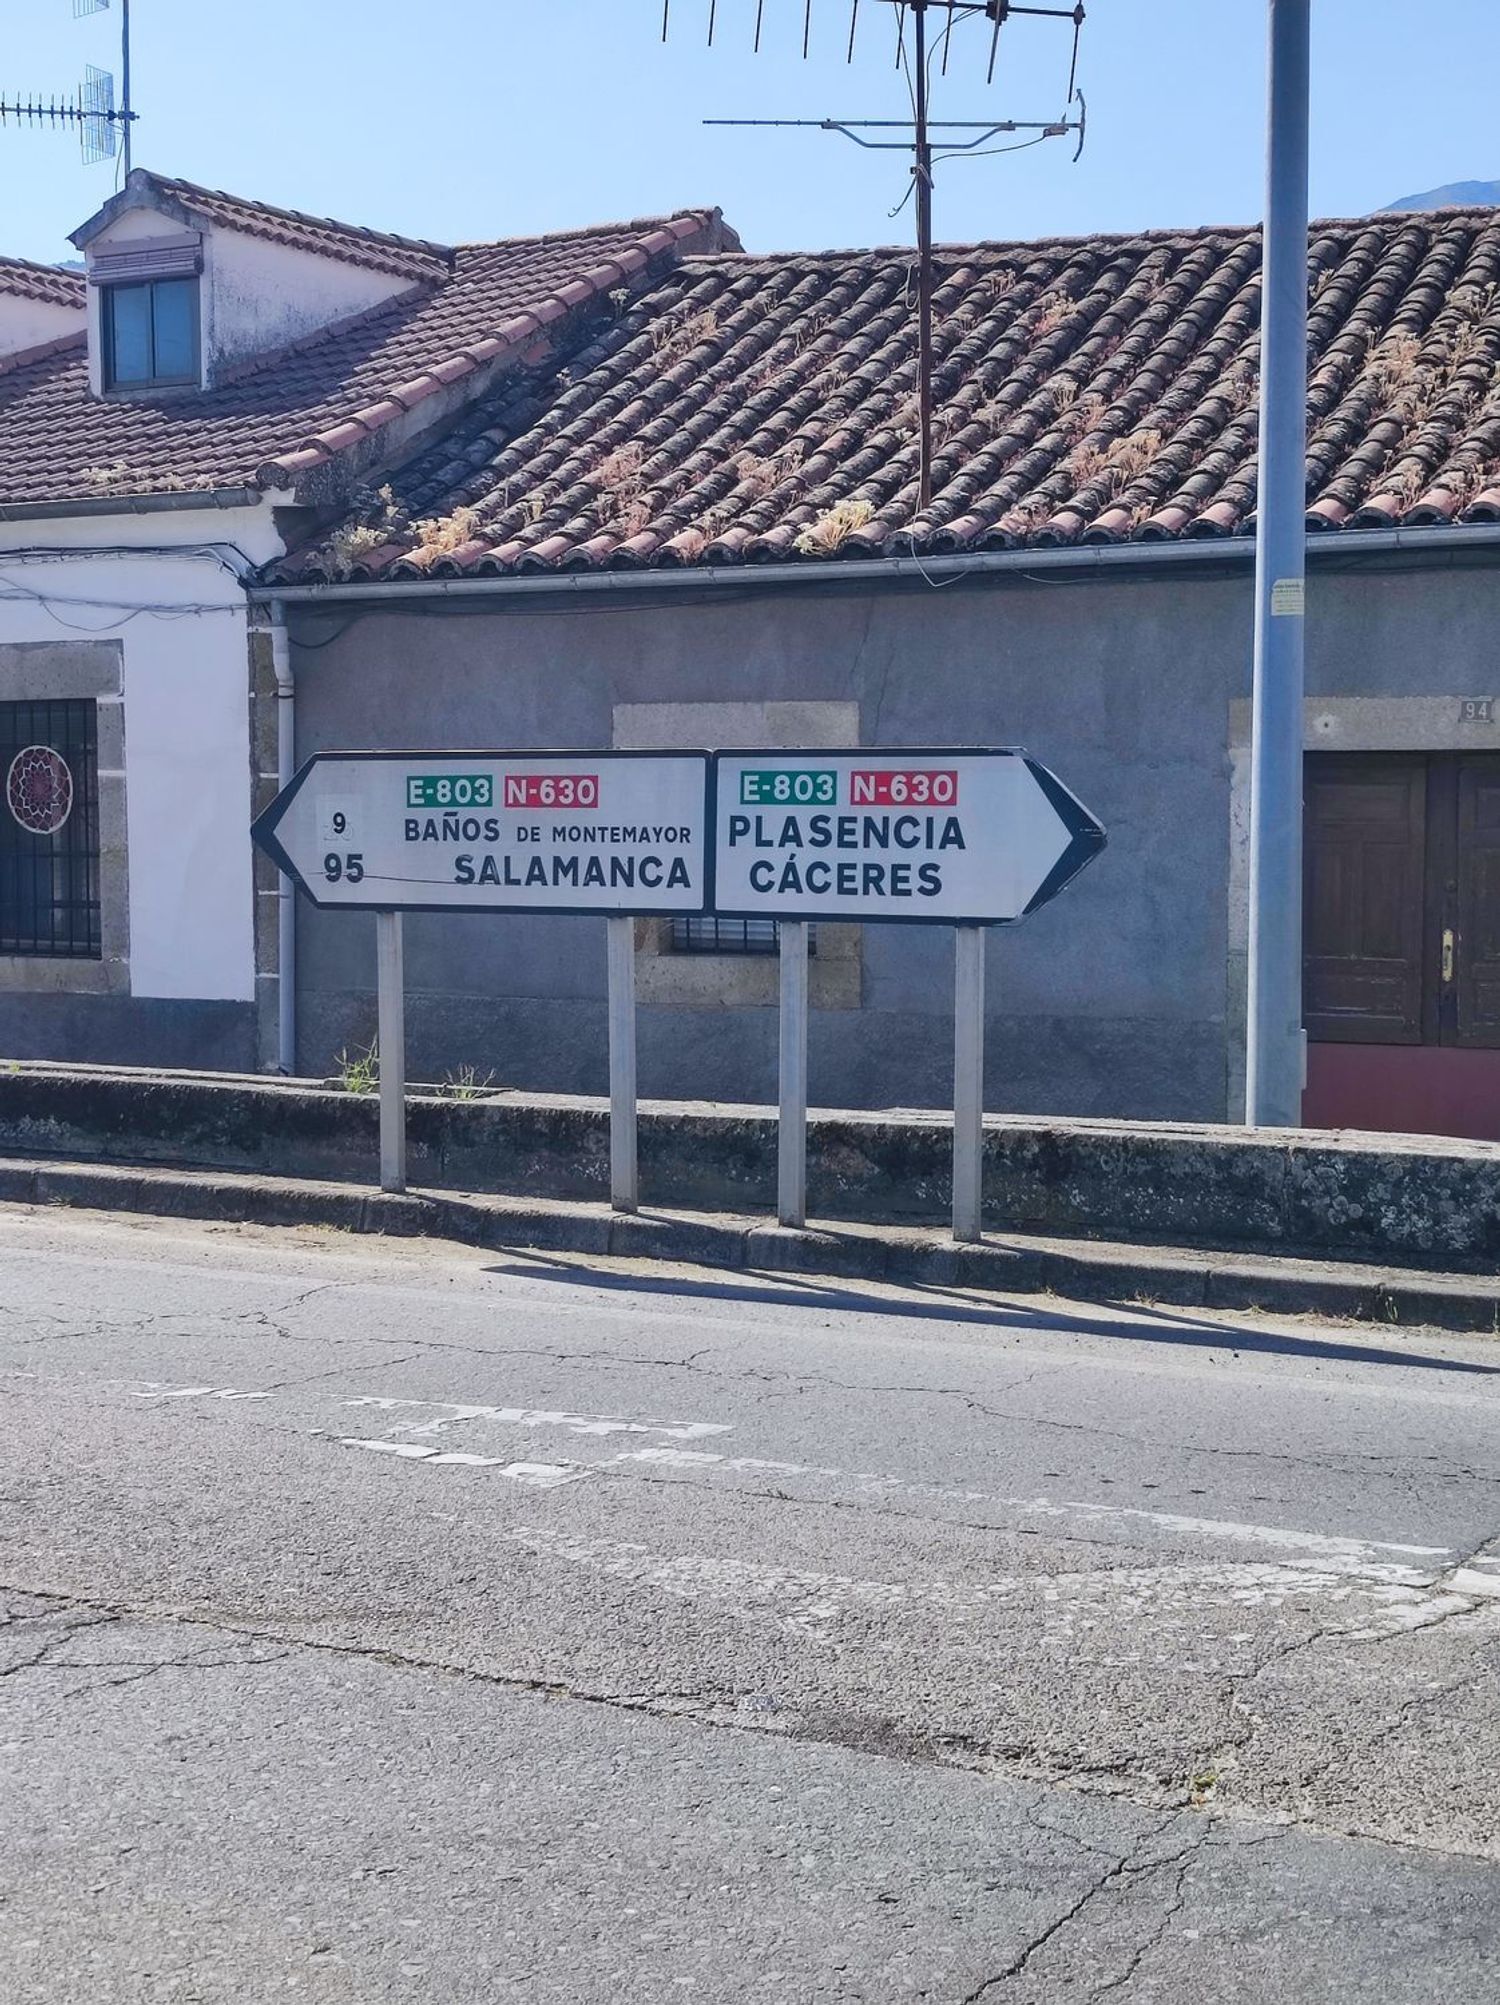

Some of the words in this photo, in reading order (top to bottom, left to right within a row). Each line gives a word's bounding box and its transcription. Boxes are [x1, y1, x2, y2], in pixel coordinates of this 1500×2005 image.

[1466, 702, 1488, 719] 94
[409, 778, 491, 805] E-803
[507, 778, 596, 805] N-630
[743, 775, 834, 801] E-803
[853, 775, 954, 802] N-630
[332, 811, 347, 835] 9
[404, 811, 500, 842] BAÑOS
[516, 826, 541, 843] DE
[552, 826, 691, 844] MONTEMAYOR
[729, 814, 966, 850] PLASENCIA
[323, 853, 364, 884] 95
[454, 853, 691, 888] SALAMANCA
[749, 853, 943, 897] CÁCERES
